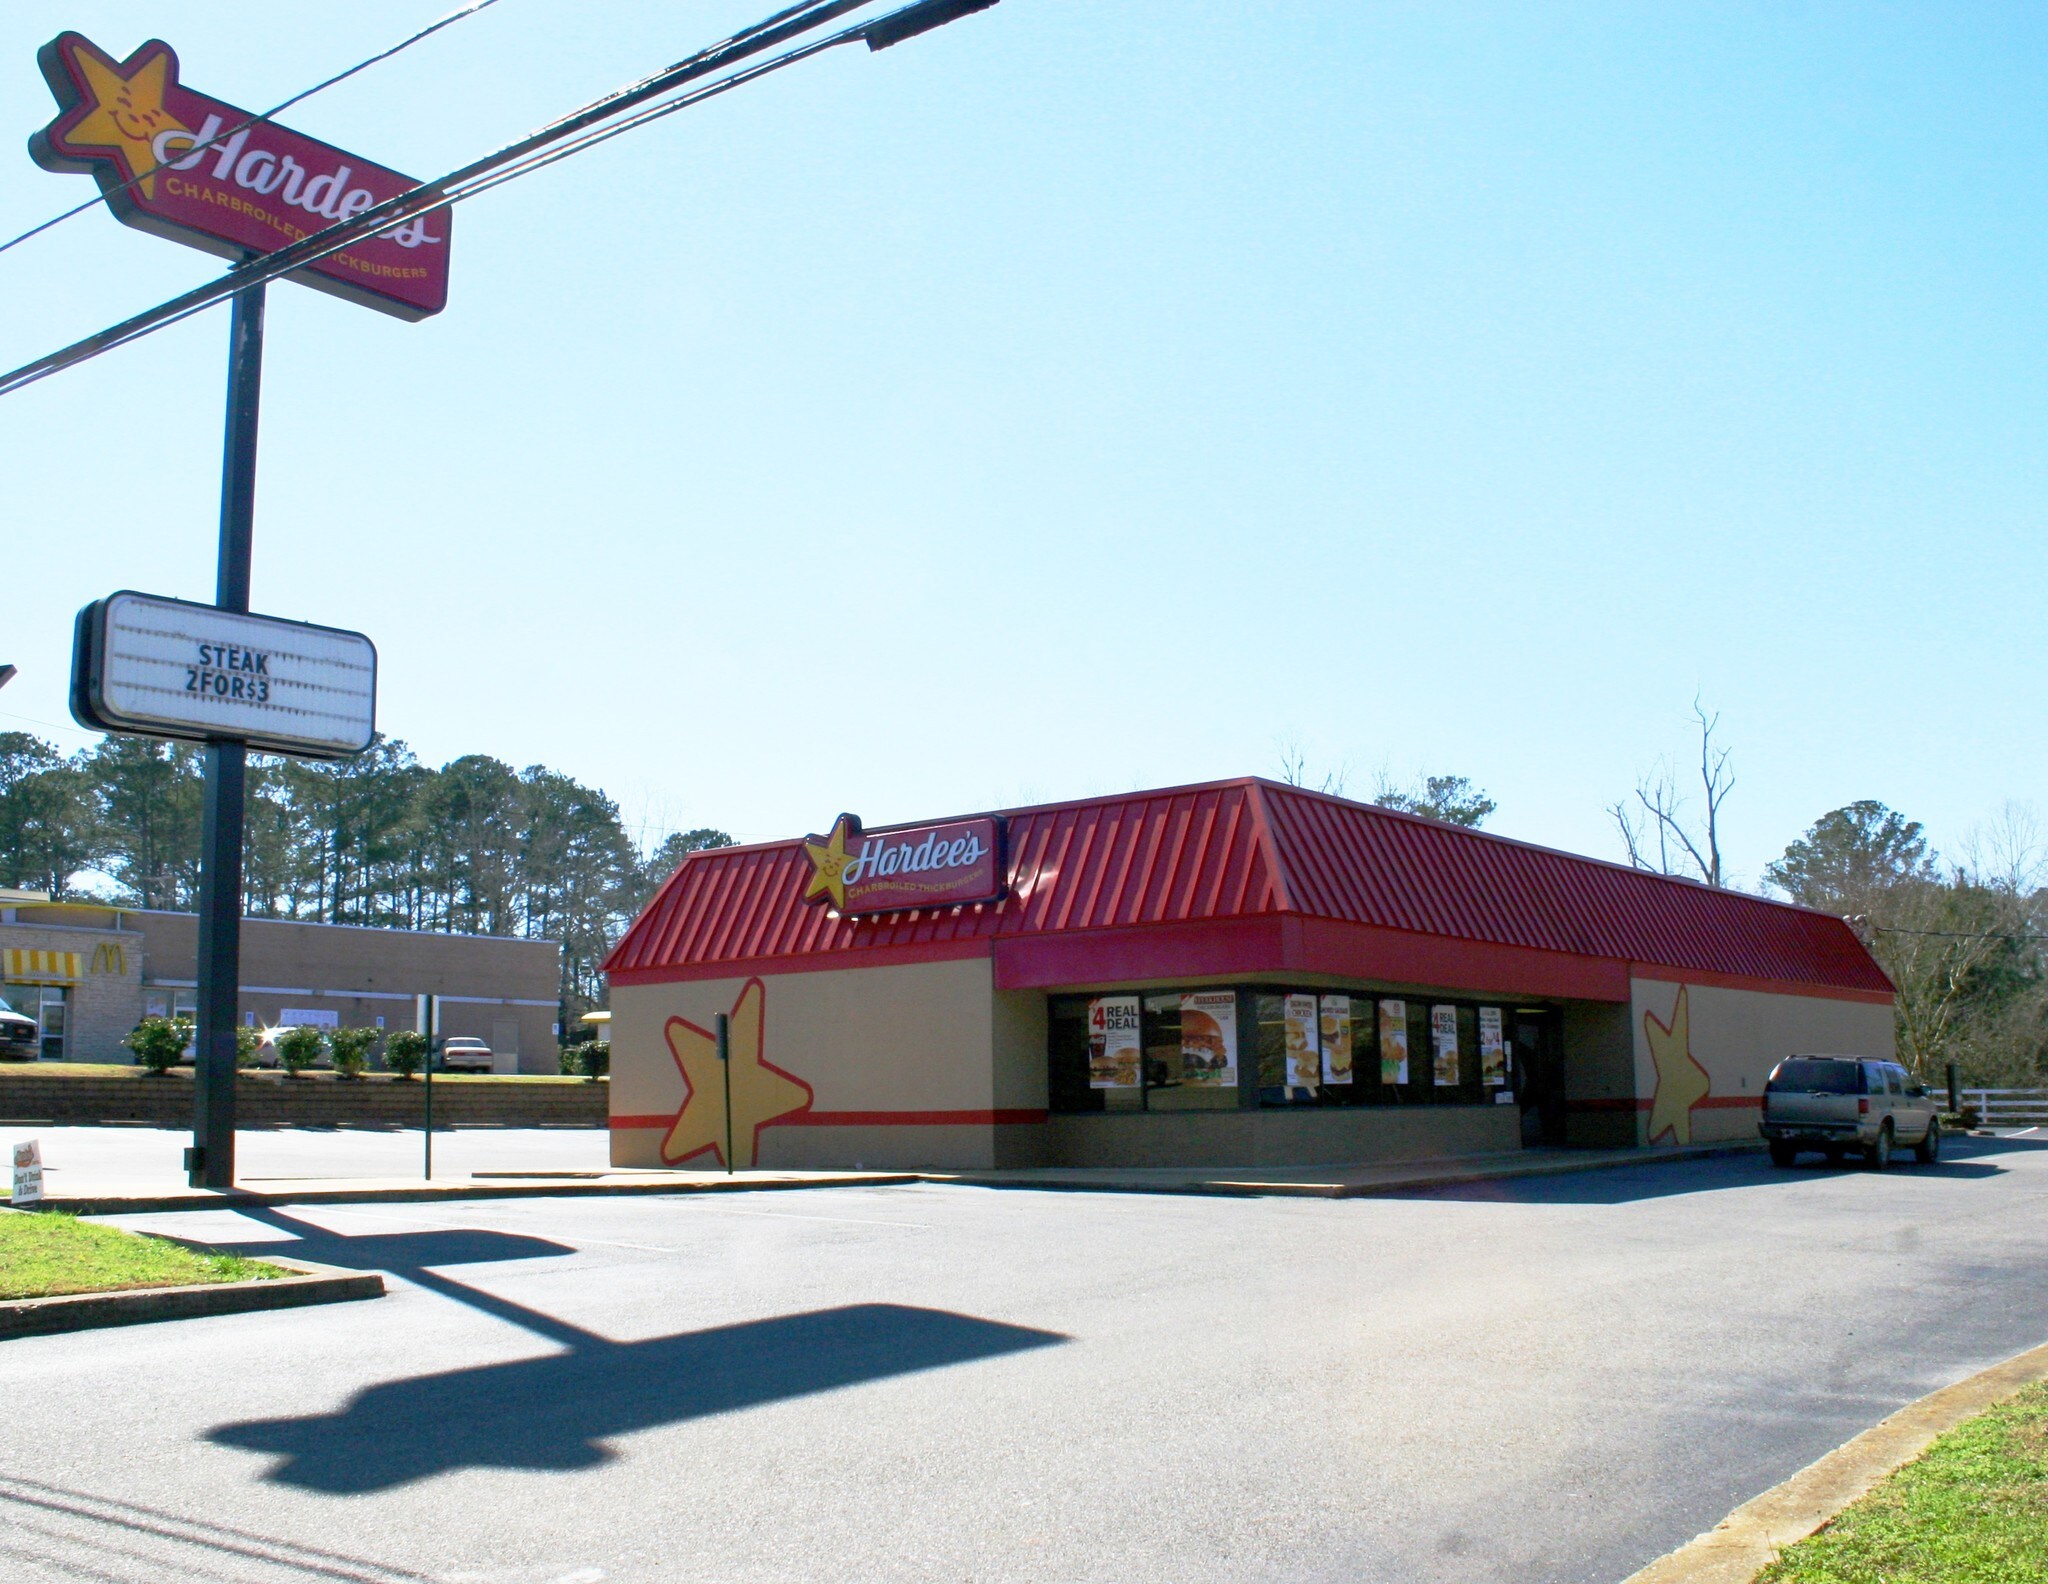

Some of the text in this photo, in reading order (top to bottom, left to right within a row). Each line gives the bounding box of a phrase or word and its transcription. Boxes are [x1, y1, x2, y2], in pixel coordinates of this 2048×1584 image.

[151, 113, 441, 249] Hardes
[166, 177, 428, 278] CHARBROILED ICKBURGERS
[199, 644, 268, 675] STEAK
[841, 831, 989, 885] Hardee's
[848, 881, 916, 898] CHARBROILED
[1107, 1005, 1138, 1018] REAL
[1440, 1012, 1455, 1023] REAL
[1107, 1018, 1138, 1030] DEAL
